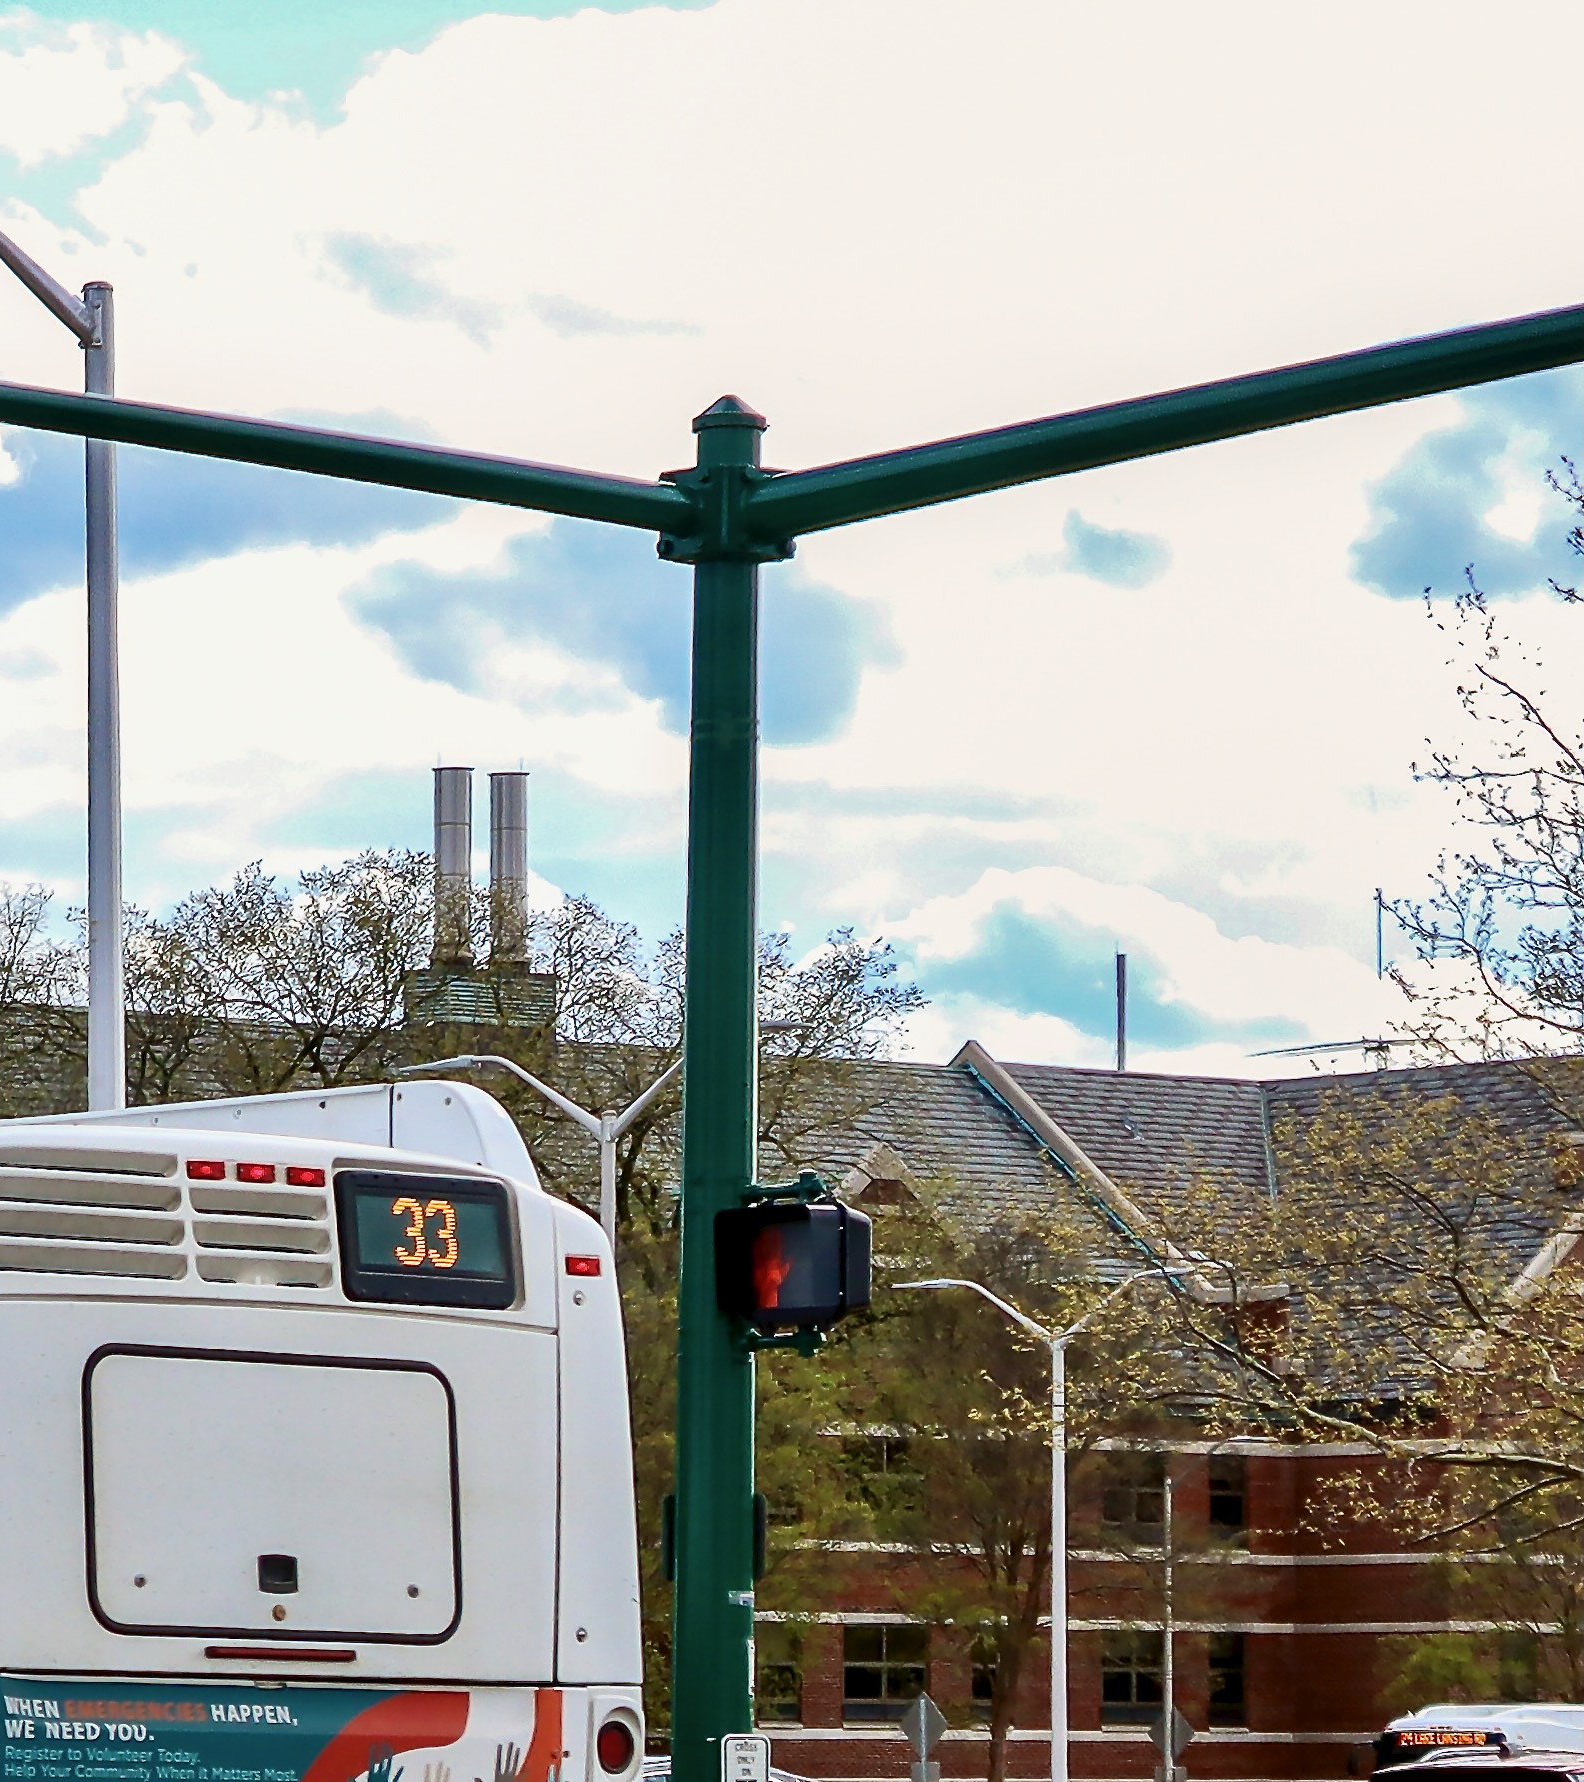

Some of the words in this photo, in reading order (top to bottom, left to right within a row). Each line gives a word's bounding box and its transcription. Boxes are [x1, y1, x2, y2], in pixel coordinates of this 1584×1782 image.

[390, 1196, 460, 1270] 33
[3, 1695, 61, 1719] WHEN
[210, 1704, 298, 1727] HAPPEN,
[4, 1719, 35, 1739] WE
[44, 1721, 101, 1741] NEED
[104, 1722, 156, 1742] YOU.
[4, 1745, 64, 1763] Register
[67, 1747, 82, 1762] to
[86, 1747, 153, 1762] Volunteer
[157, 1748, 201, 1766] Today.
[4, 1763, 37, 1780] Help
[41, 1763, 72, 1778] Your
[74, 1764, 152, 1782] Community
[156, 1766, 196, 1780] When
[211, 1767, 262, 1781] Matters
